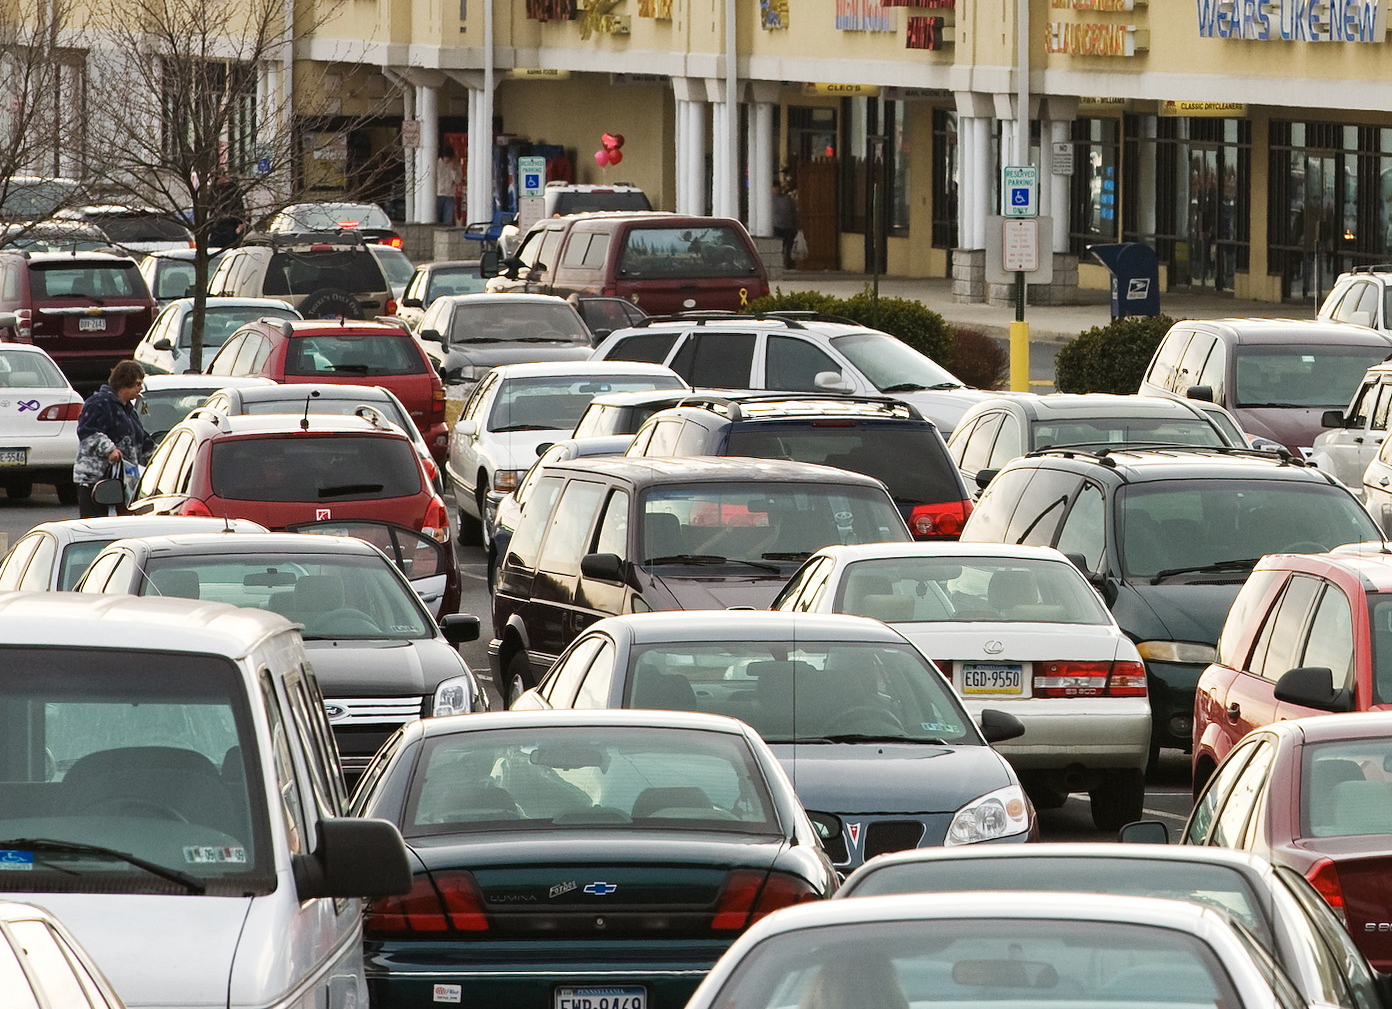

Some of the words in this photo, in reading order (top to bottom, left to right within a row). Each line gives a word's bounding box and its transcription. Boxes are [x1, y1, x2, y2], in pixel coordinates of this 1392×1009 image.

[1180, 102, 1203, 110] CLASSIC
[1006, 170, 1035, 178] RESERVED
[1008, 178, 1033, 186] PARKING
[489, 894, 537, 902] LUMINA
